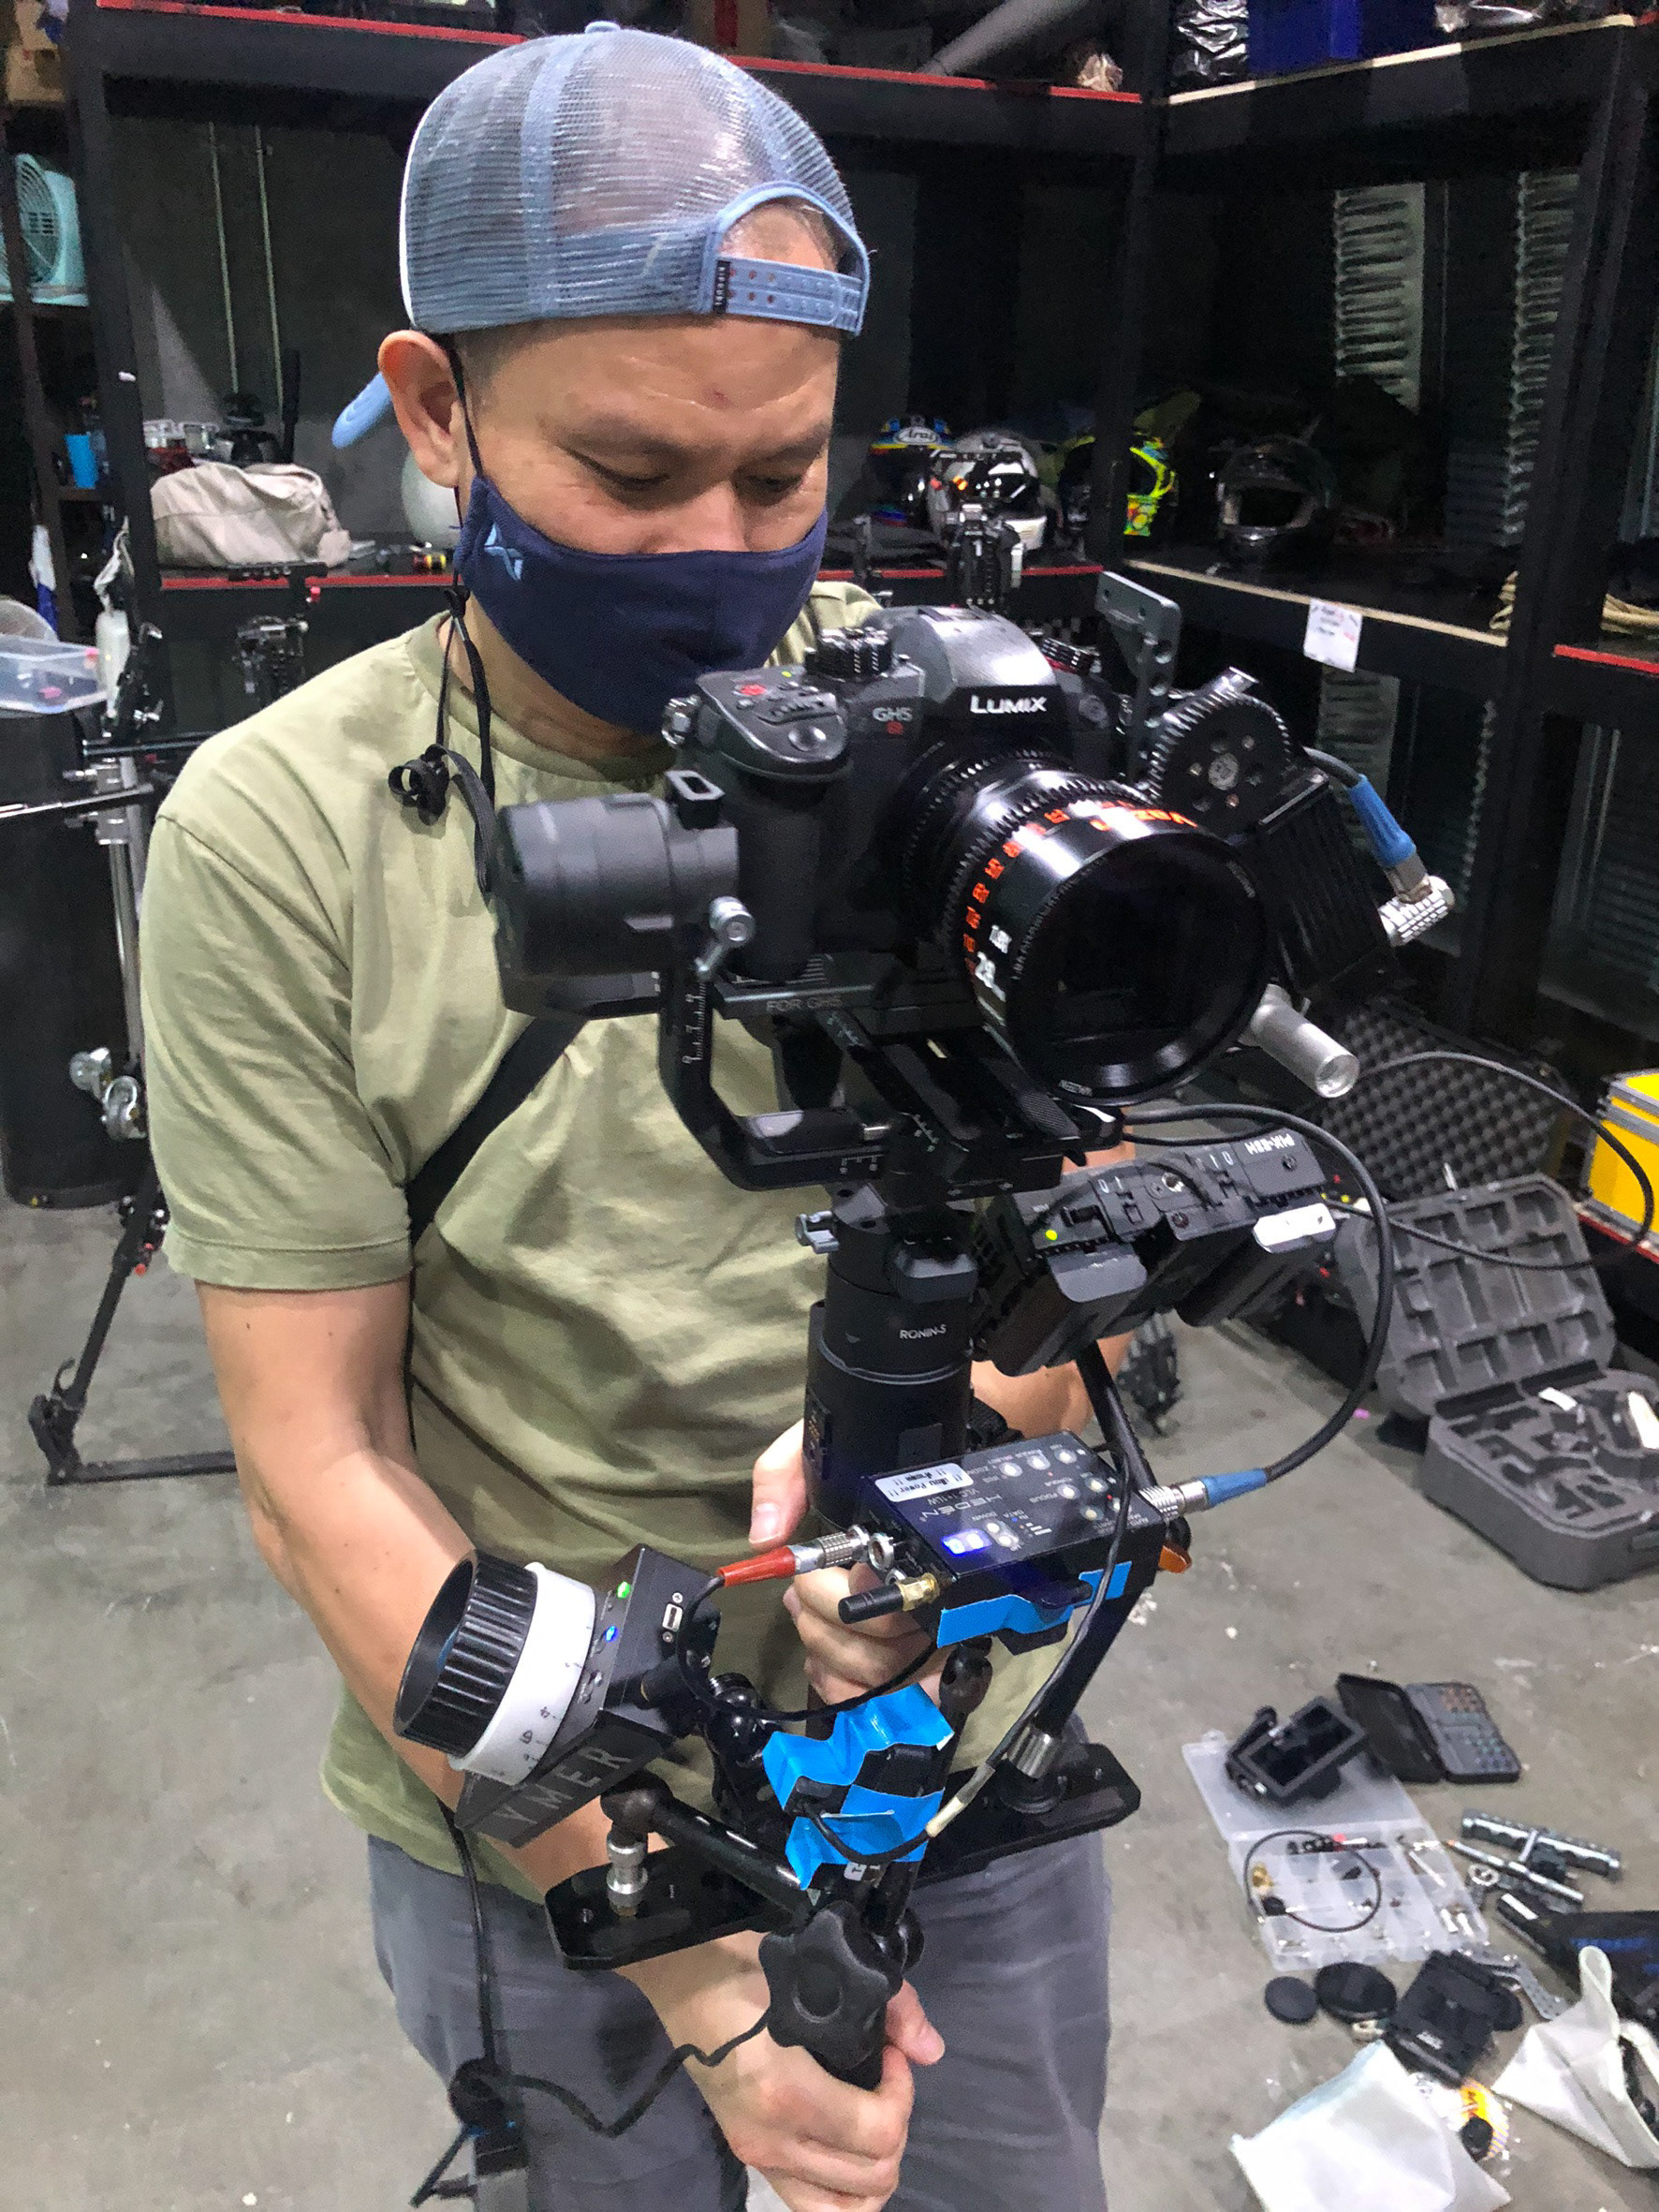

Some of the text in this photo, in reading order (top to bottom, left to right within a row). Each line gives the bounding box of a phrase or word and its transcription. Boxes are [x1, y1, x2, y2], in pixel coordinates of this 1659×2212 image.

[970, 694, 1048, 714] LUMIX
[873, 706, 913, 722] GH5
[766, 998, 803, 1012] FOR
[899, 1323, 947, 1339] RONIN-S
[900, 1482, 927, 1494] Power
